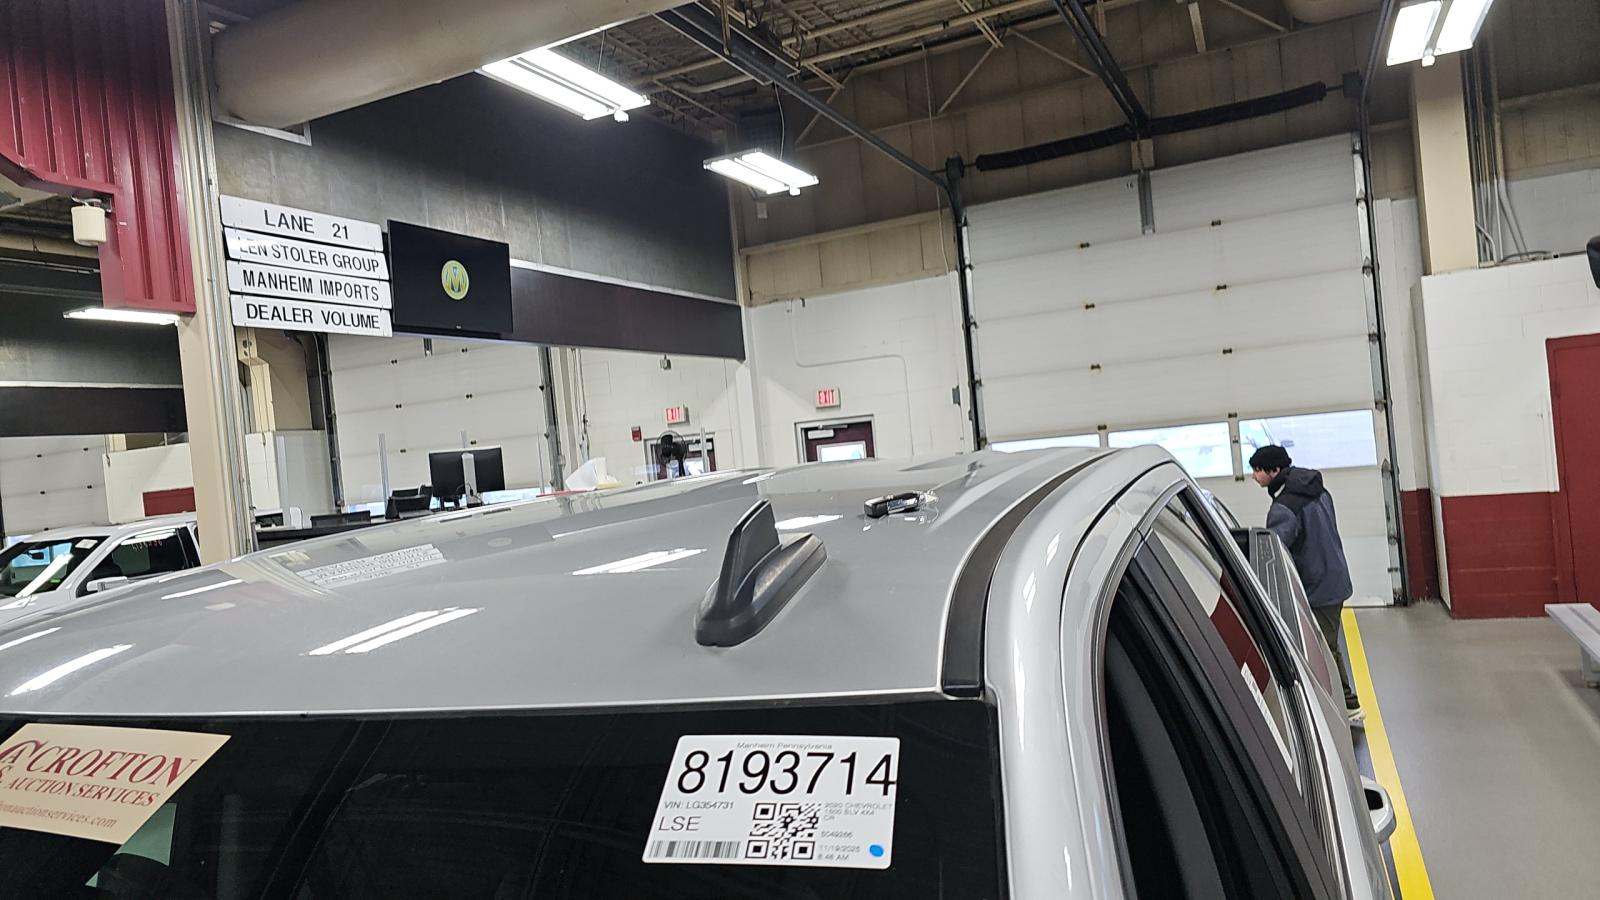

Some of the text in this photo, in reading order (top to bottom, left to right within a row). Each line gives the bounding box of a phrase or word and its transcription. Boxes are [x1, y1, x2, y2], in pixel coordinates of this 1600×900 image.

[263, 209, 349, 240] LANE 21
[271, 244, 328, 266] STOLER
[332, 253, 379, 272] GROUP
[242, 269, 380, 301] MANHEIM IMPORTS
[245, 303, 381, 330] DEALER VOLUME
[818, 388, 835, 405] EXIT
[665, 407, 682, 421] EXIT
[27, 744, 198, 788] CROFTON
[677, 749, 897, 796] 8193714
[9, 776, 160, 806] AUCTION SERVICES
[664, 801, 683, 809] VIN:
[658, 816, 702, 831] LSE
